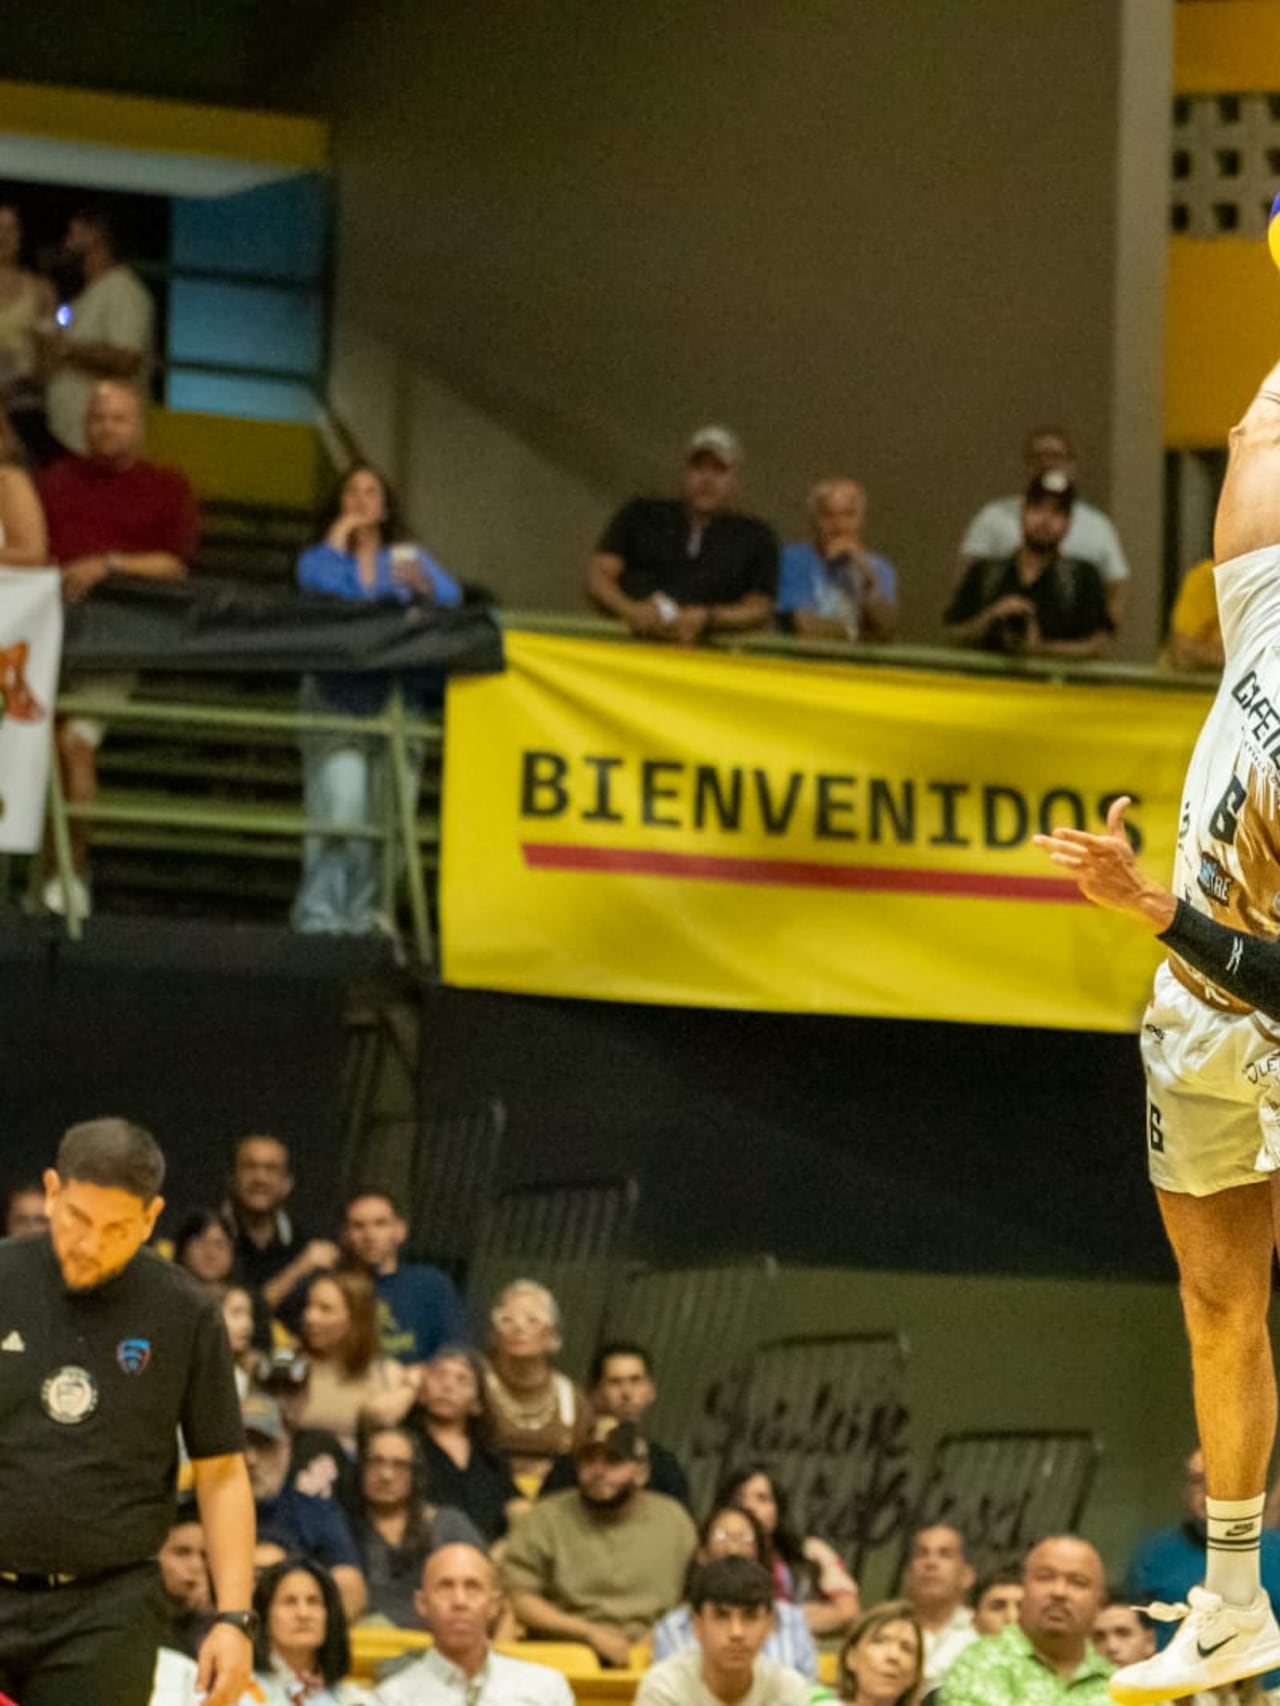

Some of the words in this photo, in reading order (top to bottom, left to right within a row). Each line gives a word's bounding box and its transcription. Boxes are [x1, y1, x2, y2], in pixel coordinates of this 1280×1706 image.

[520, 750, 1144, 857] BIENVENIDOS
[1209, 776, 1247, 846] 6
[1150, 1102, 1165, 1153] 6
